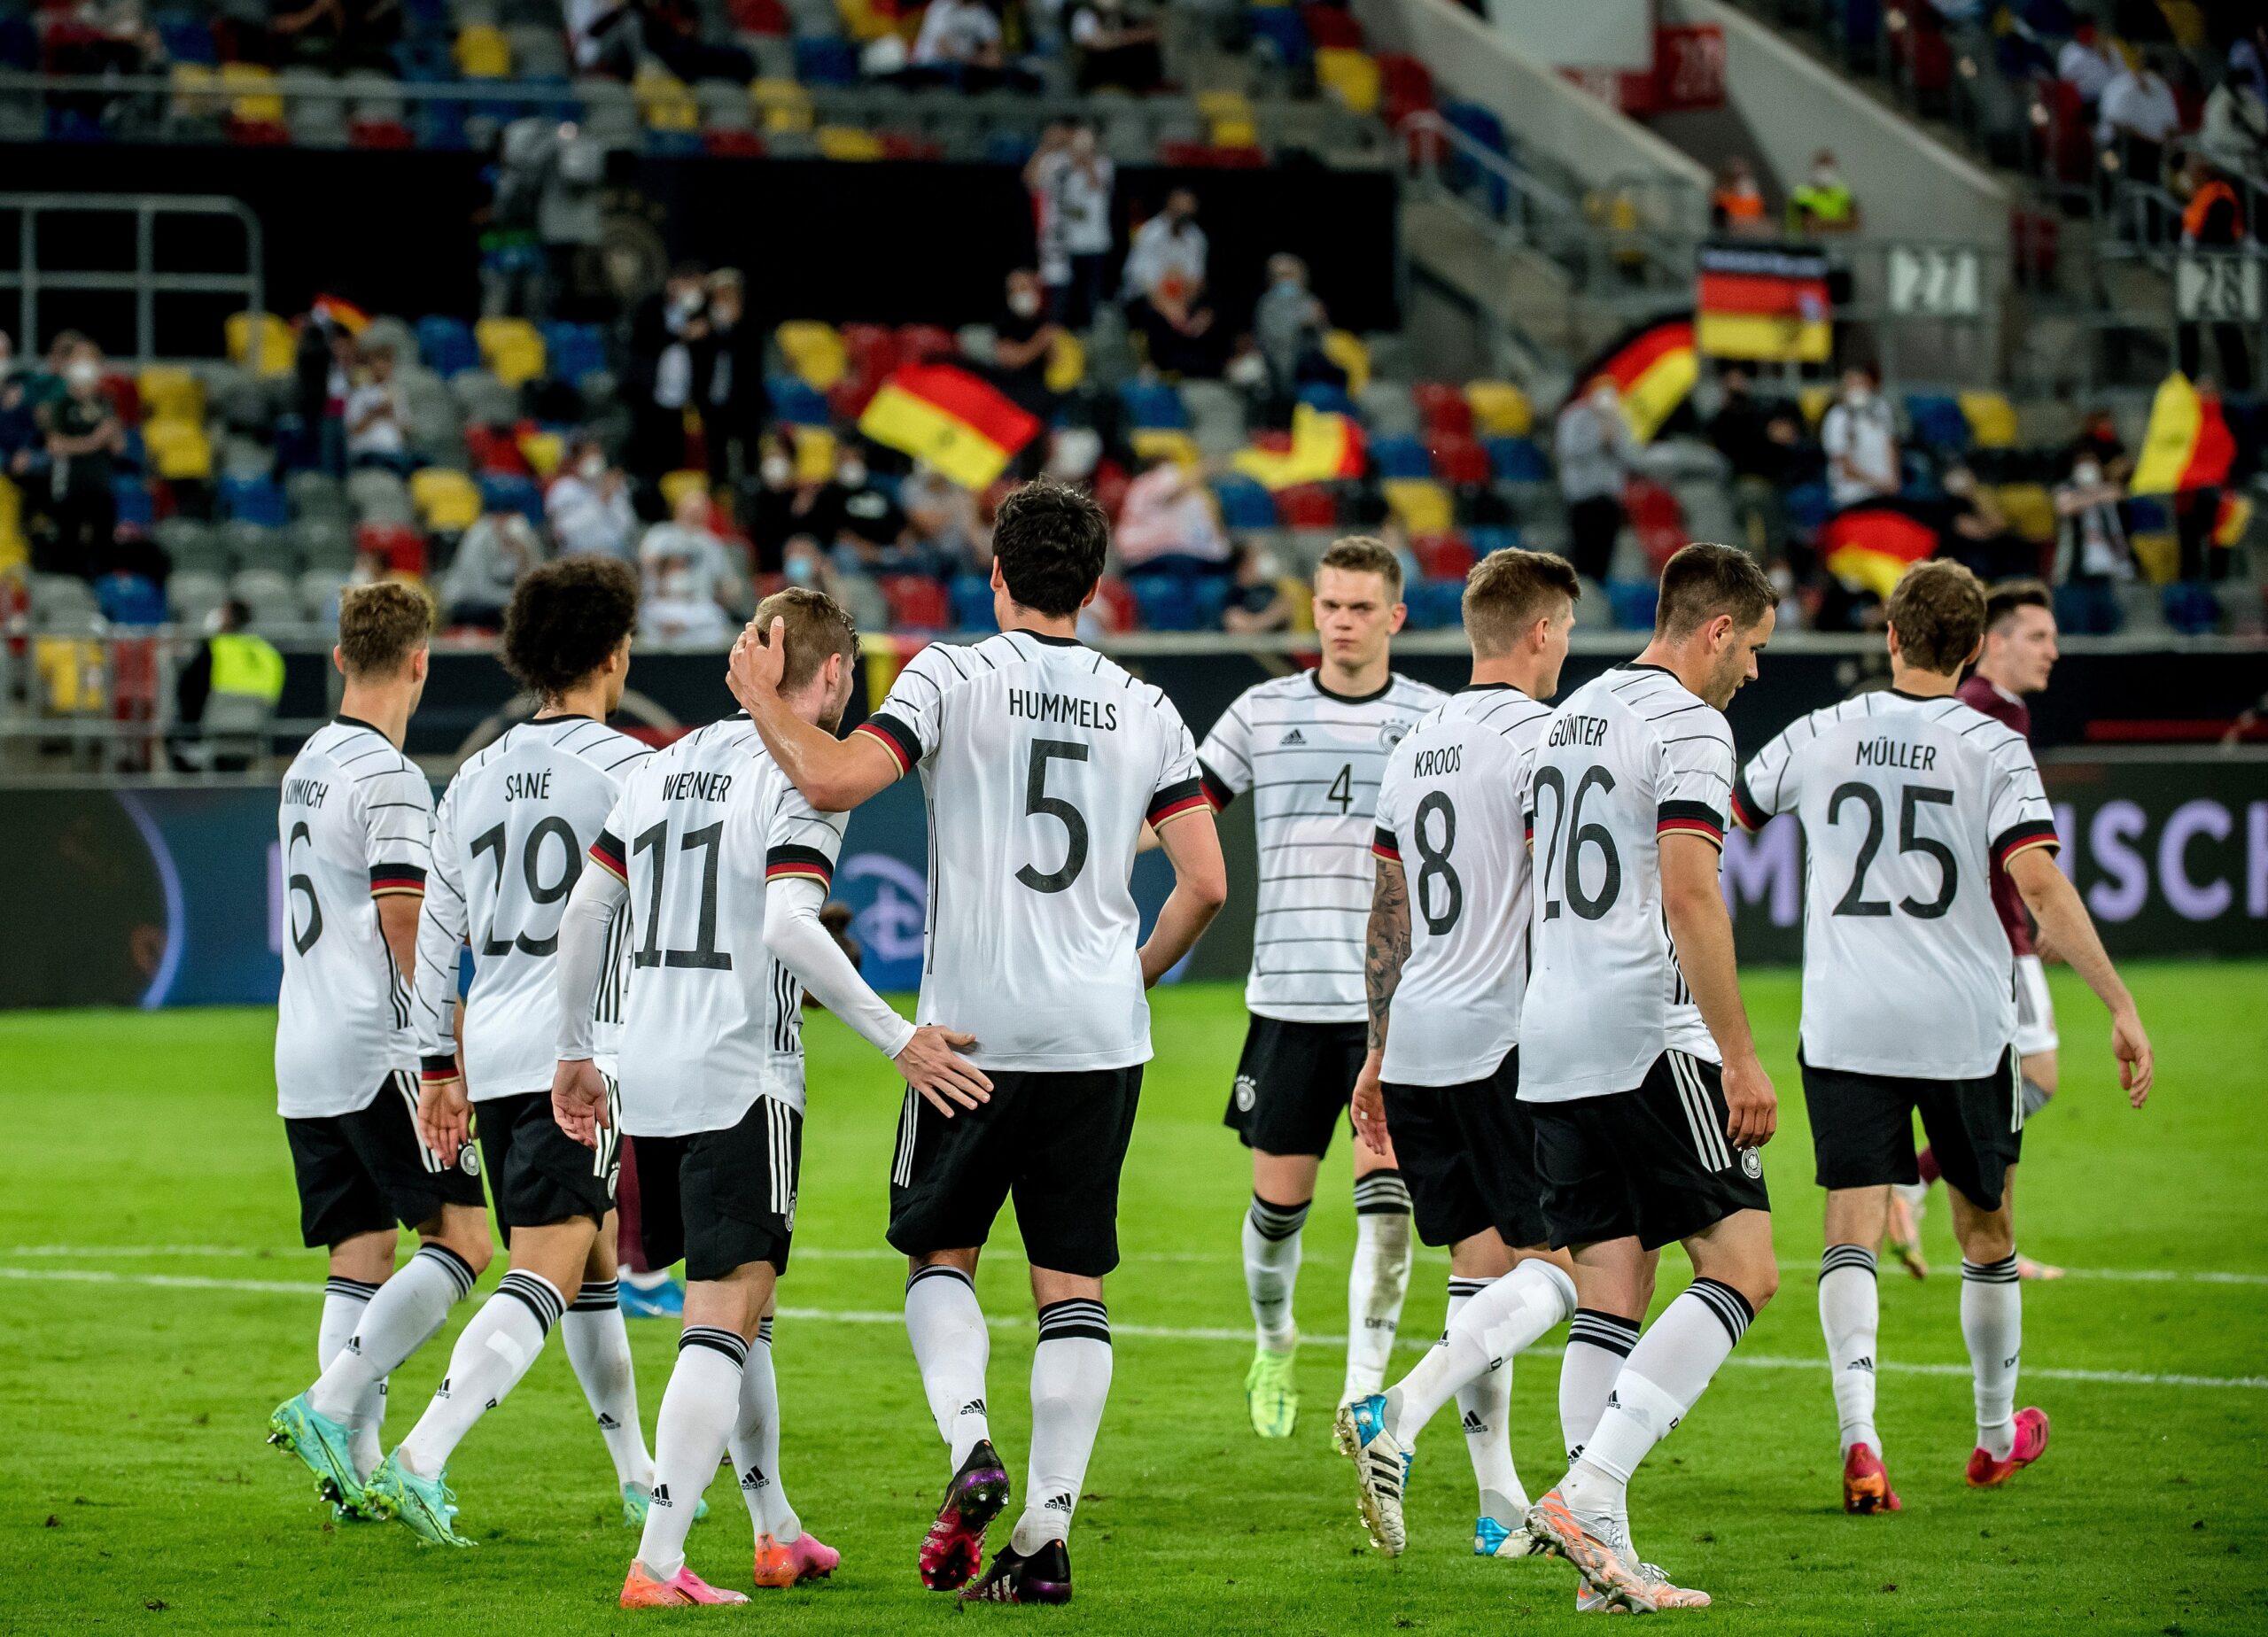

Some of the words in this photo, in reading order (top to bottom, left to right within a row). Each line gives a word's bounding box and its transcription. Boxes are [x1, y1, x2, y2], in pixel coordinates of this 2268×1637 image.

[1009, 688, 1117, 732] HUMMELS
[1549, 713, 1608, 748] GÜNTER
[1855, 736, 1937, 771] MÜLLER
[505, 768, 552, 803] SANÉ
[663, 771, 732, 803] WERNER
[1327, 764, 1354, 815] 4
[1414, 744, 1463, 779] KROOS
[1014, 738, 1089, 894] 5
[1533, 764, 1621, 922] 26
[1828, 781, 1958, 920] 25
[289, 821, 322, 958] 6
[470, 816, 583, 957] 19
[633, 818, 733, 971] 11
[1414, 791, 1463, 936] 8
